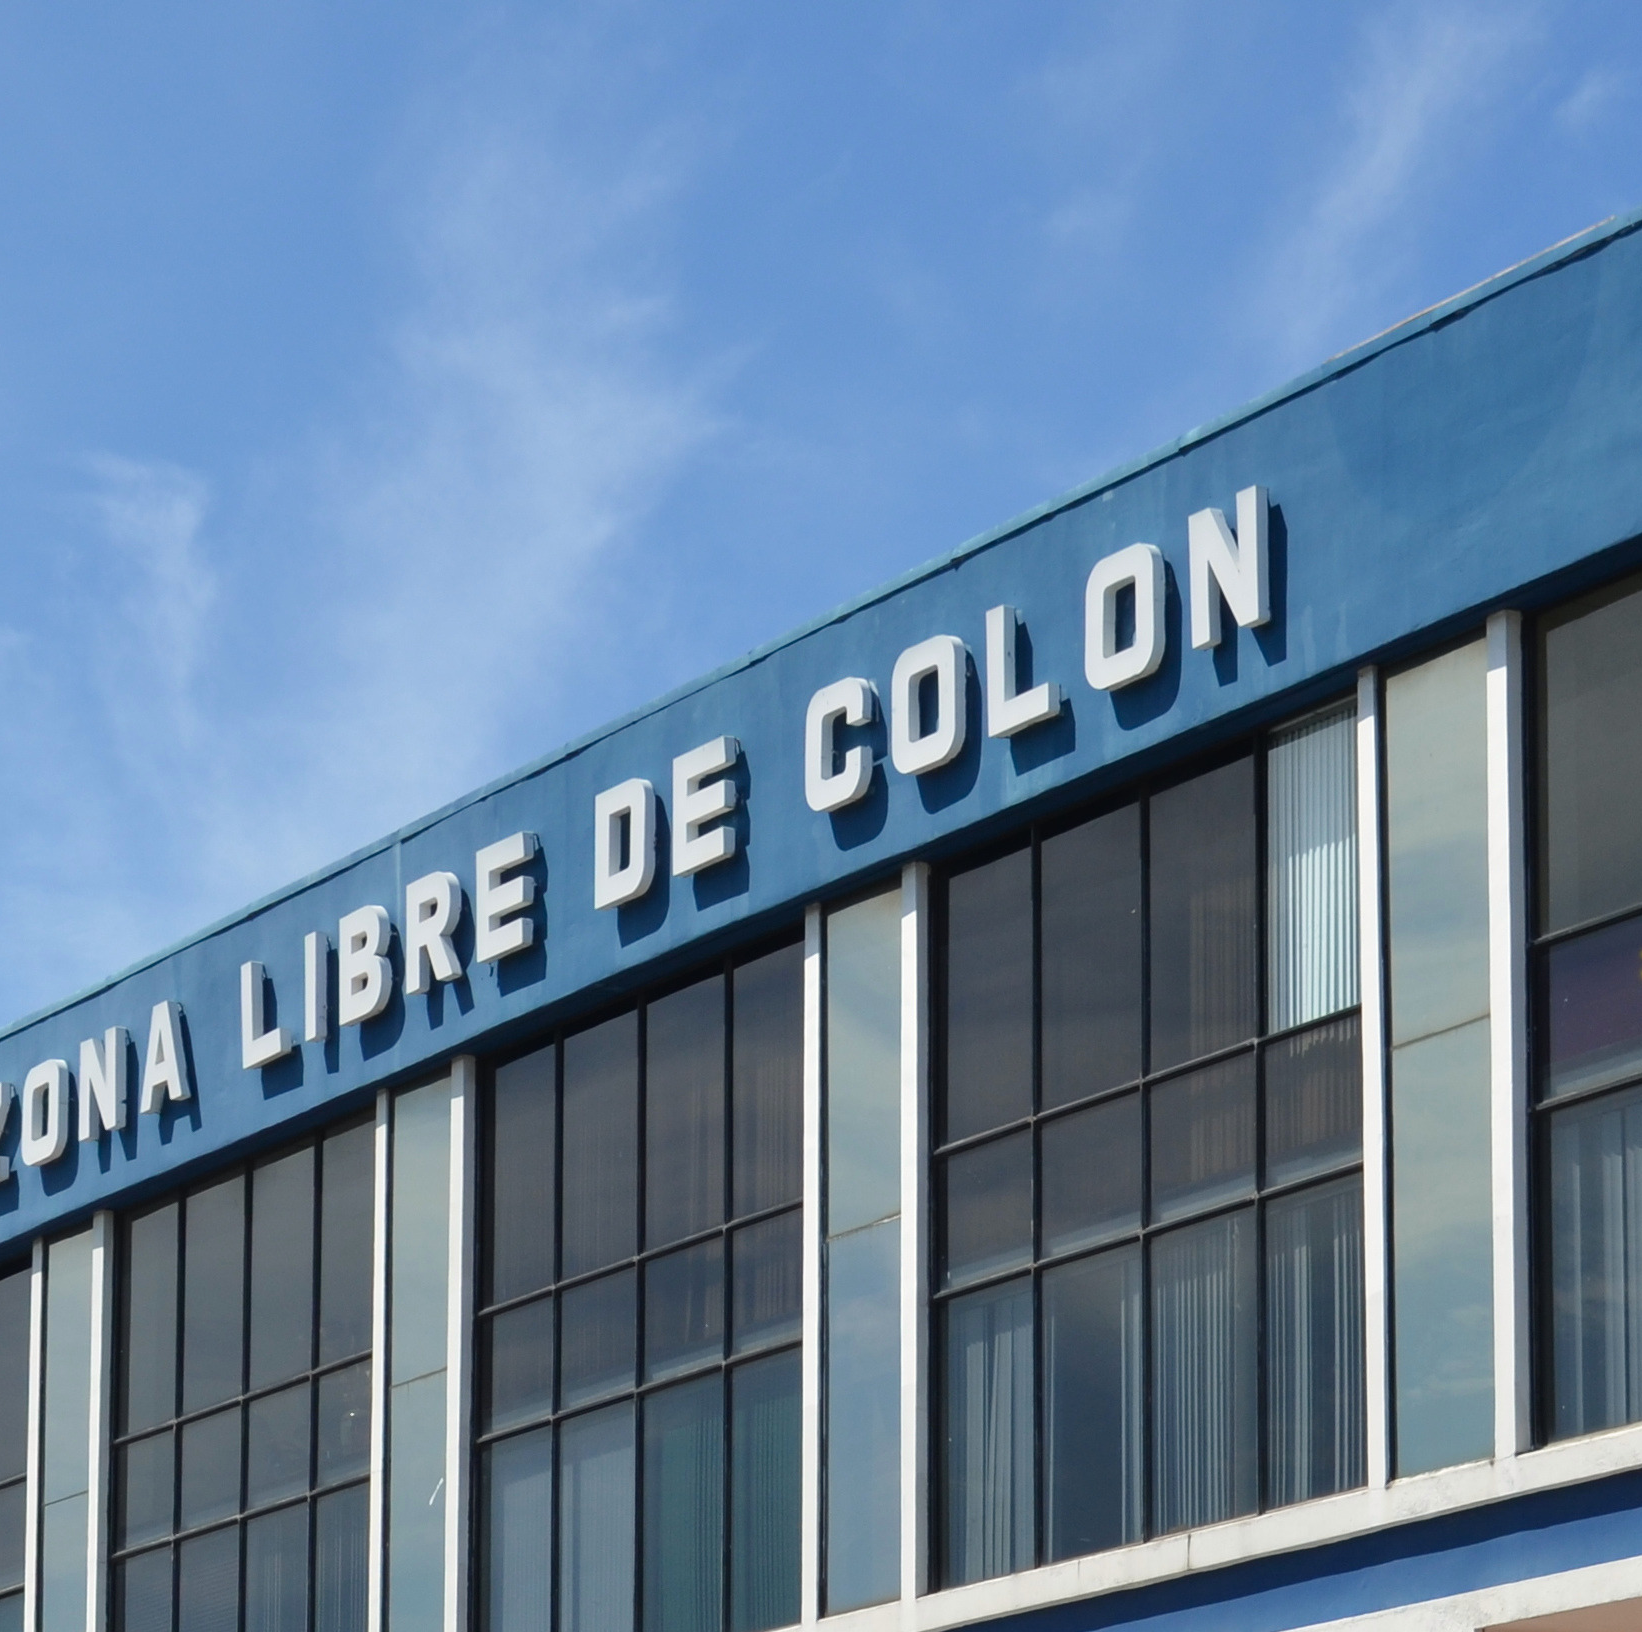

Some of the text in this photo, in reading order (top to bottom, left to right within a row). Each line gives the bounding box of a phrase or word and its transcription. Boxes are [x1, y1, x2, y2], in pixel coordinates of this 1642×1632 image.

[240, 831, 535, 1070] LIBRE
[595, 736, 738, 909] DE
[806, 485, 1269, 813] COLON
